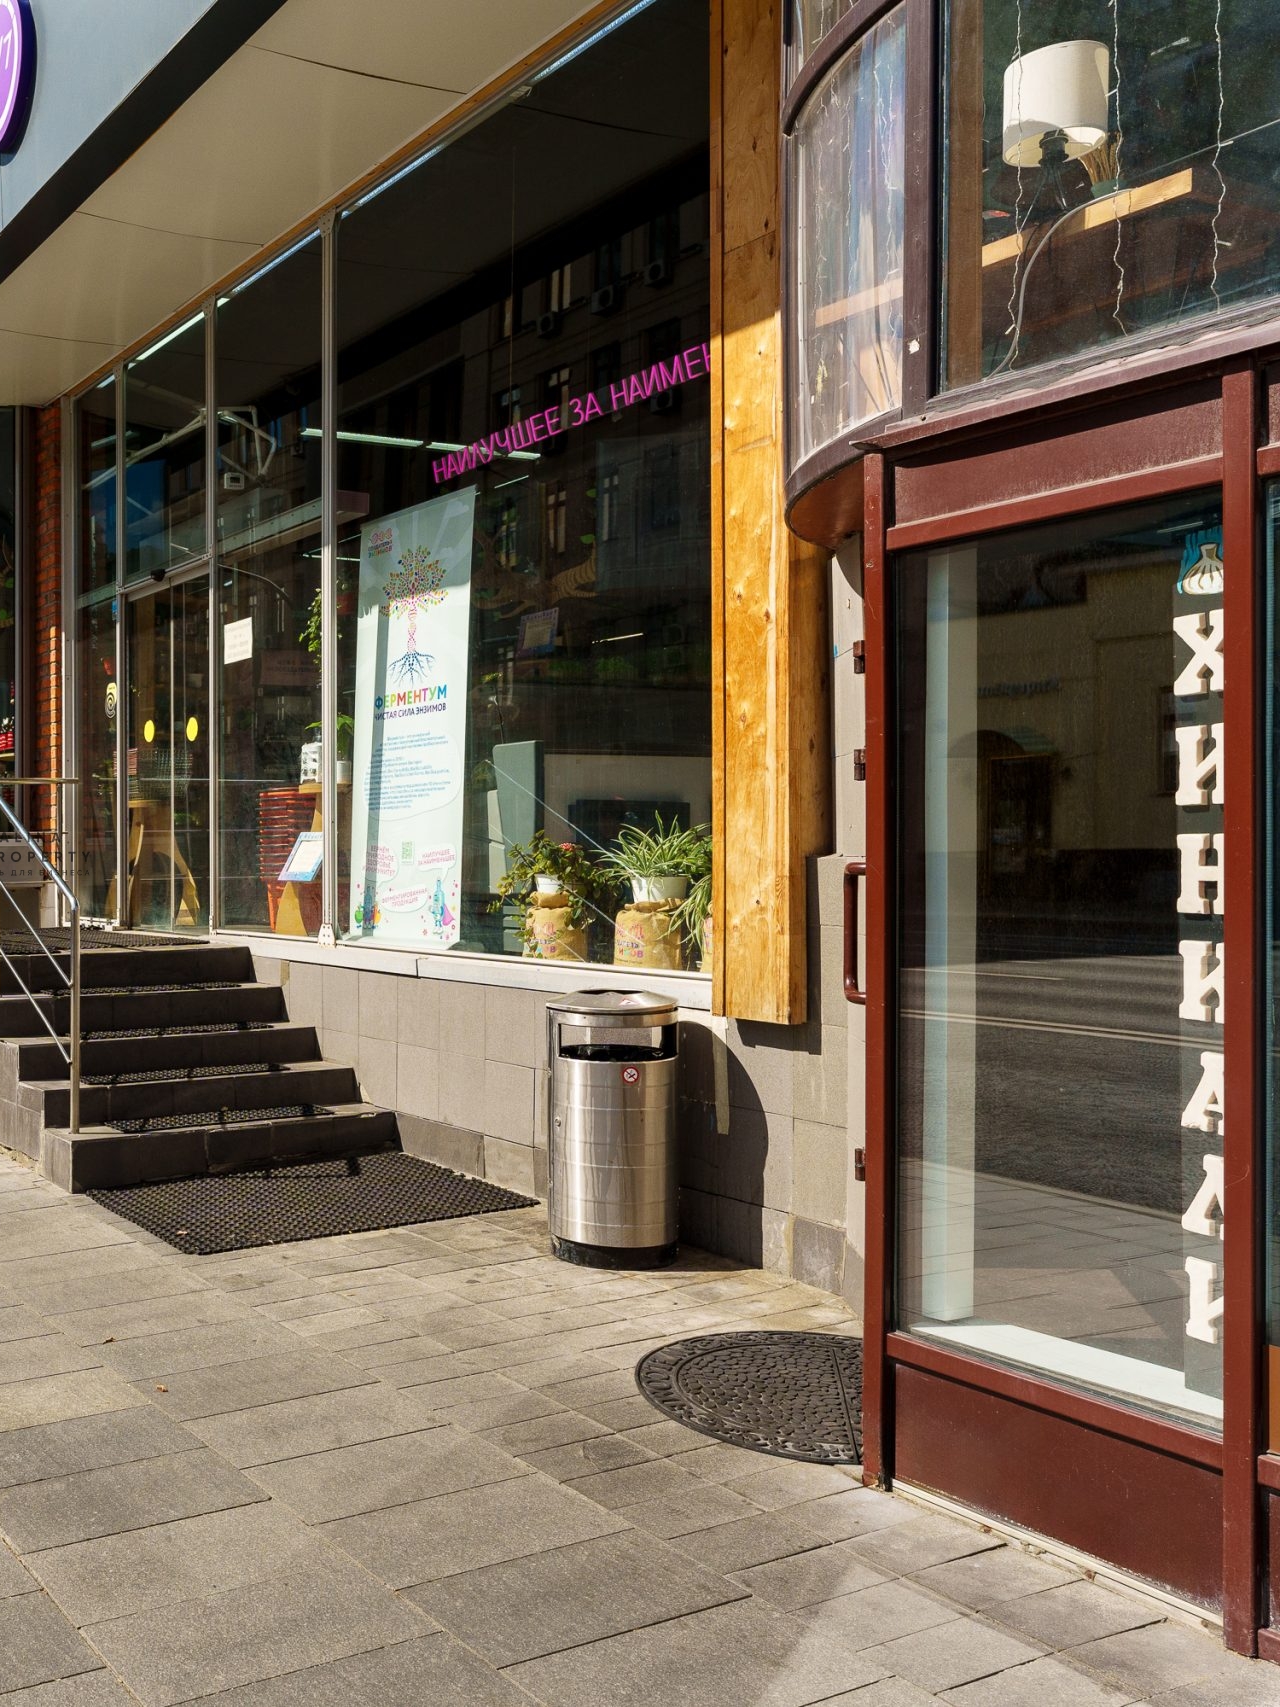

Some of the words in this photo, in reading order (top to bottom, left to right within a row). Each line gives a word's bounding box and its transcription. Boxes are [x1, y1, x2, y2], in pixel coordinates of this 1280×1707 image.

[432, 405, 562, 484] НАИЛУЧШЕЕ
[569, 391, 604, 427] ЗА
[375, 684, 447, 710] ФЕРМЕНТУМ
[398, 707, 415, 718] СИЛА
[416, 703, 447, 715] ЭНЗИМОВ
